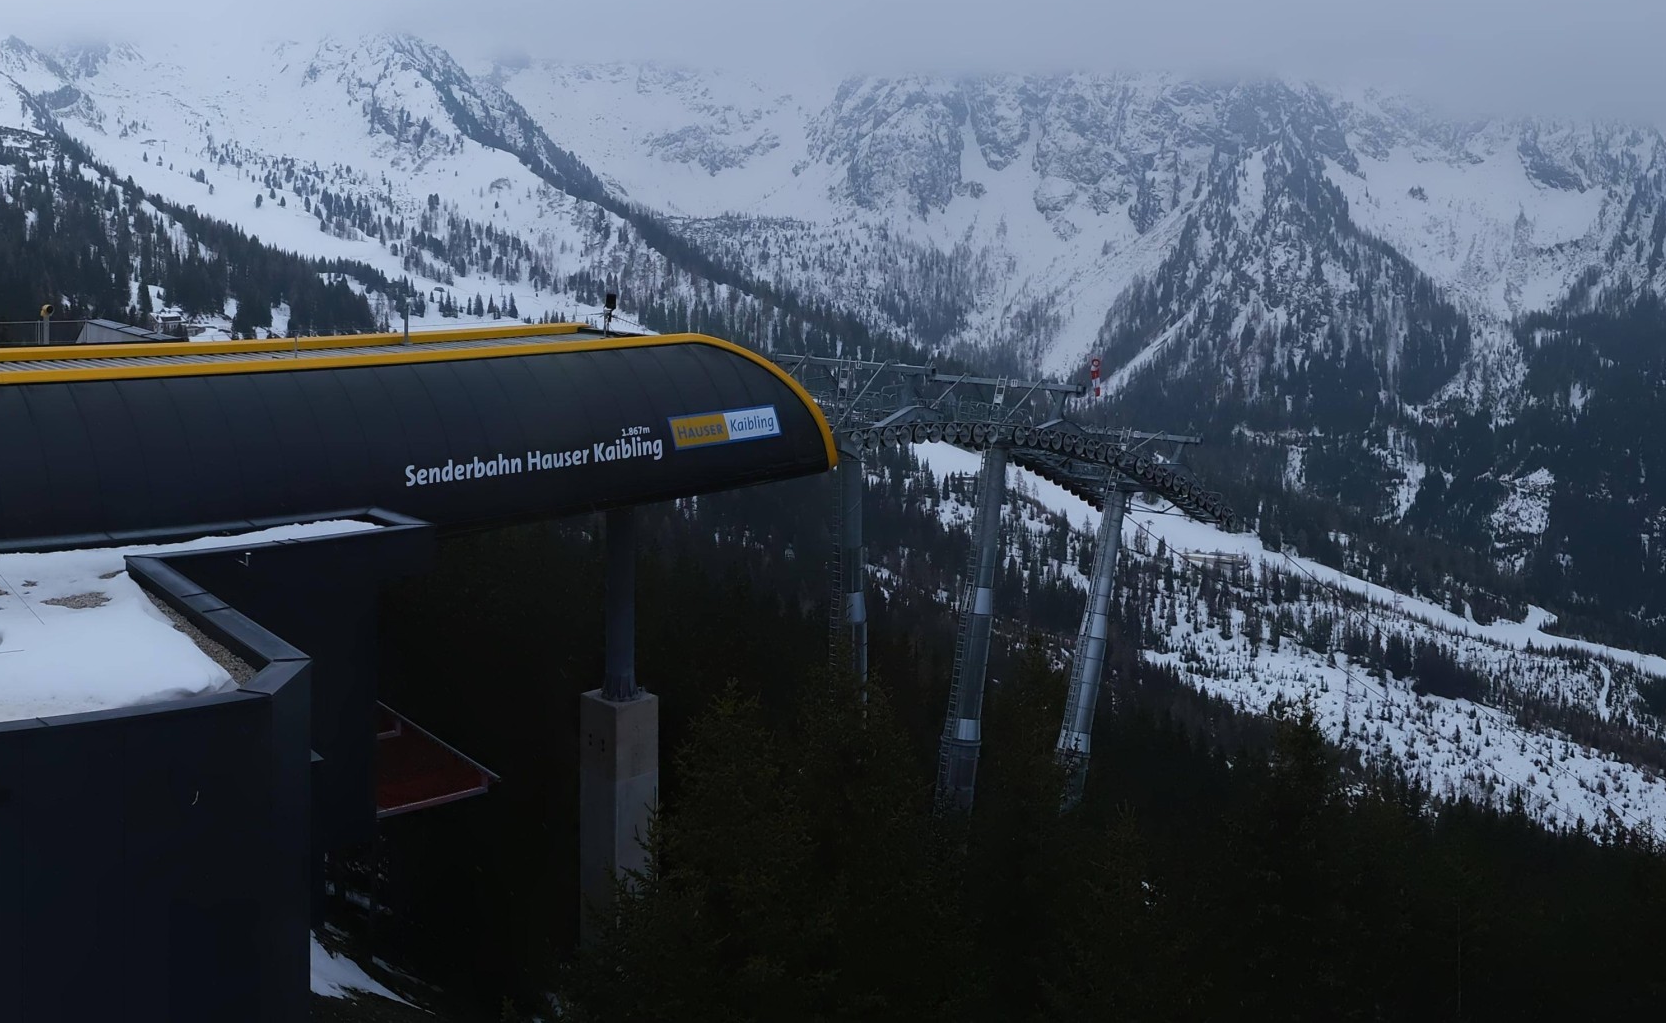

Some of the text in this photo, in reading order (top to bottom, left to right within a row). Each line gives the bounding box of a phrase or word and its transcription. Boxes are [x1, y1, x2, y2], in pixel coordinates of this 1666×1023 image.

[621, 426, 651, 437] 1.867m
[677, 416, 774, 440] HAUSER Kaibling
[405, 436, 663, 487] Senderbahn Hauser Kaibling
